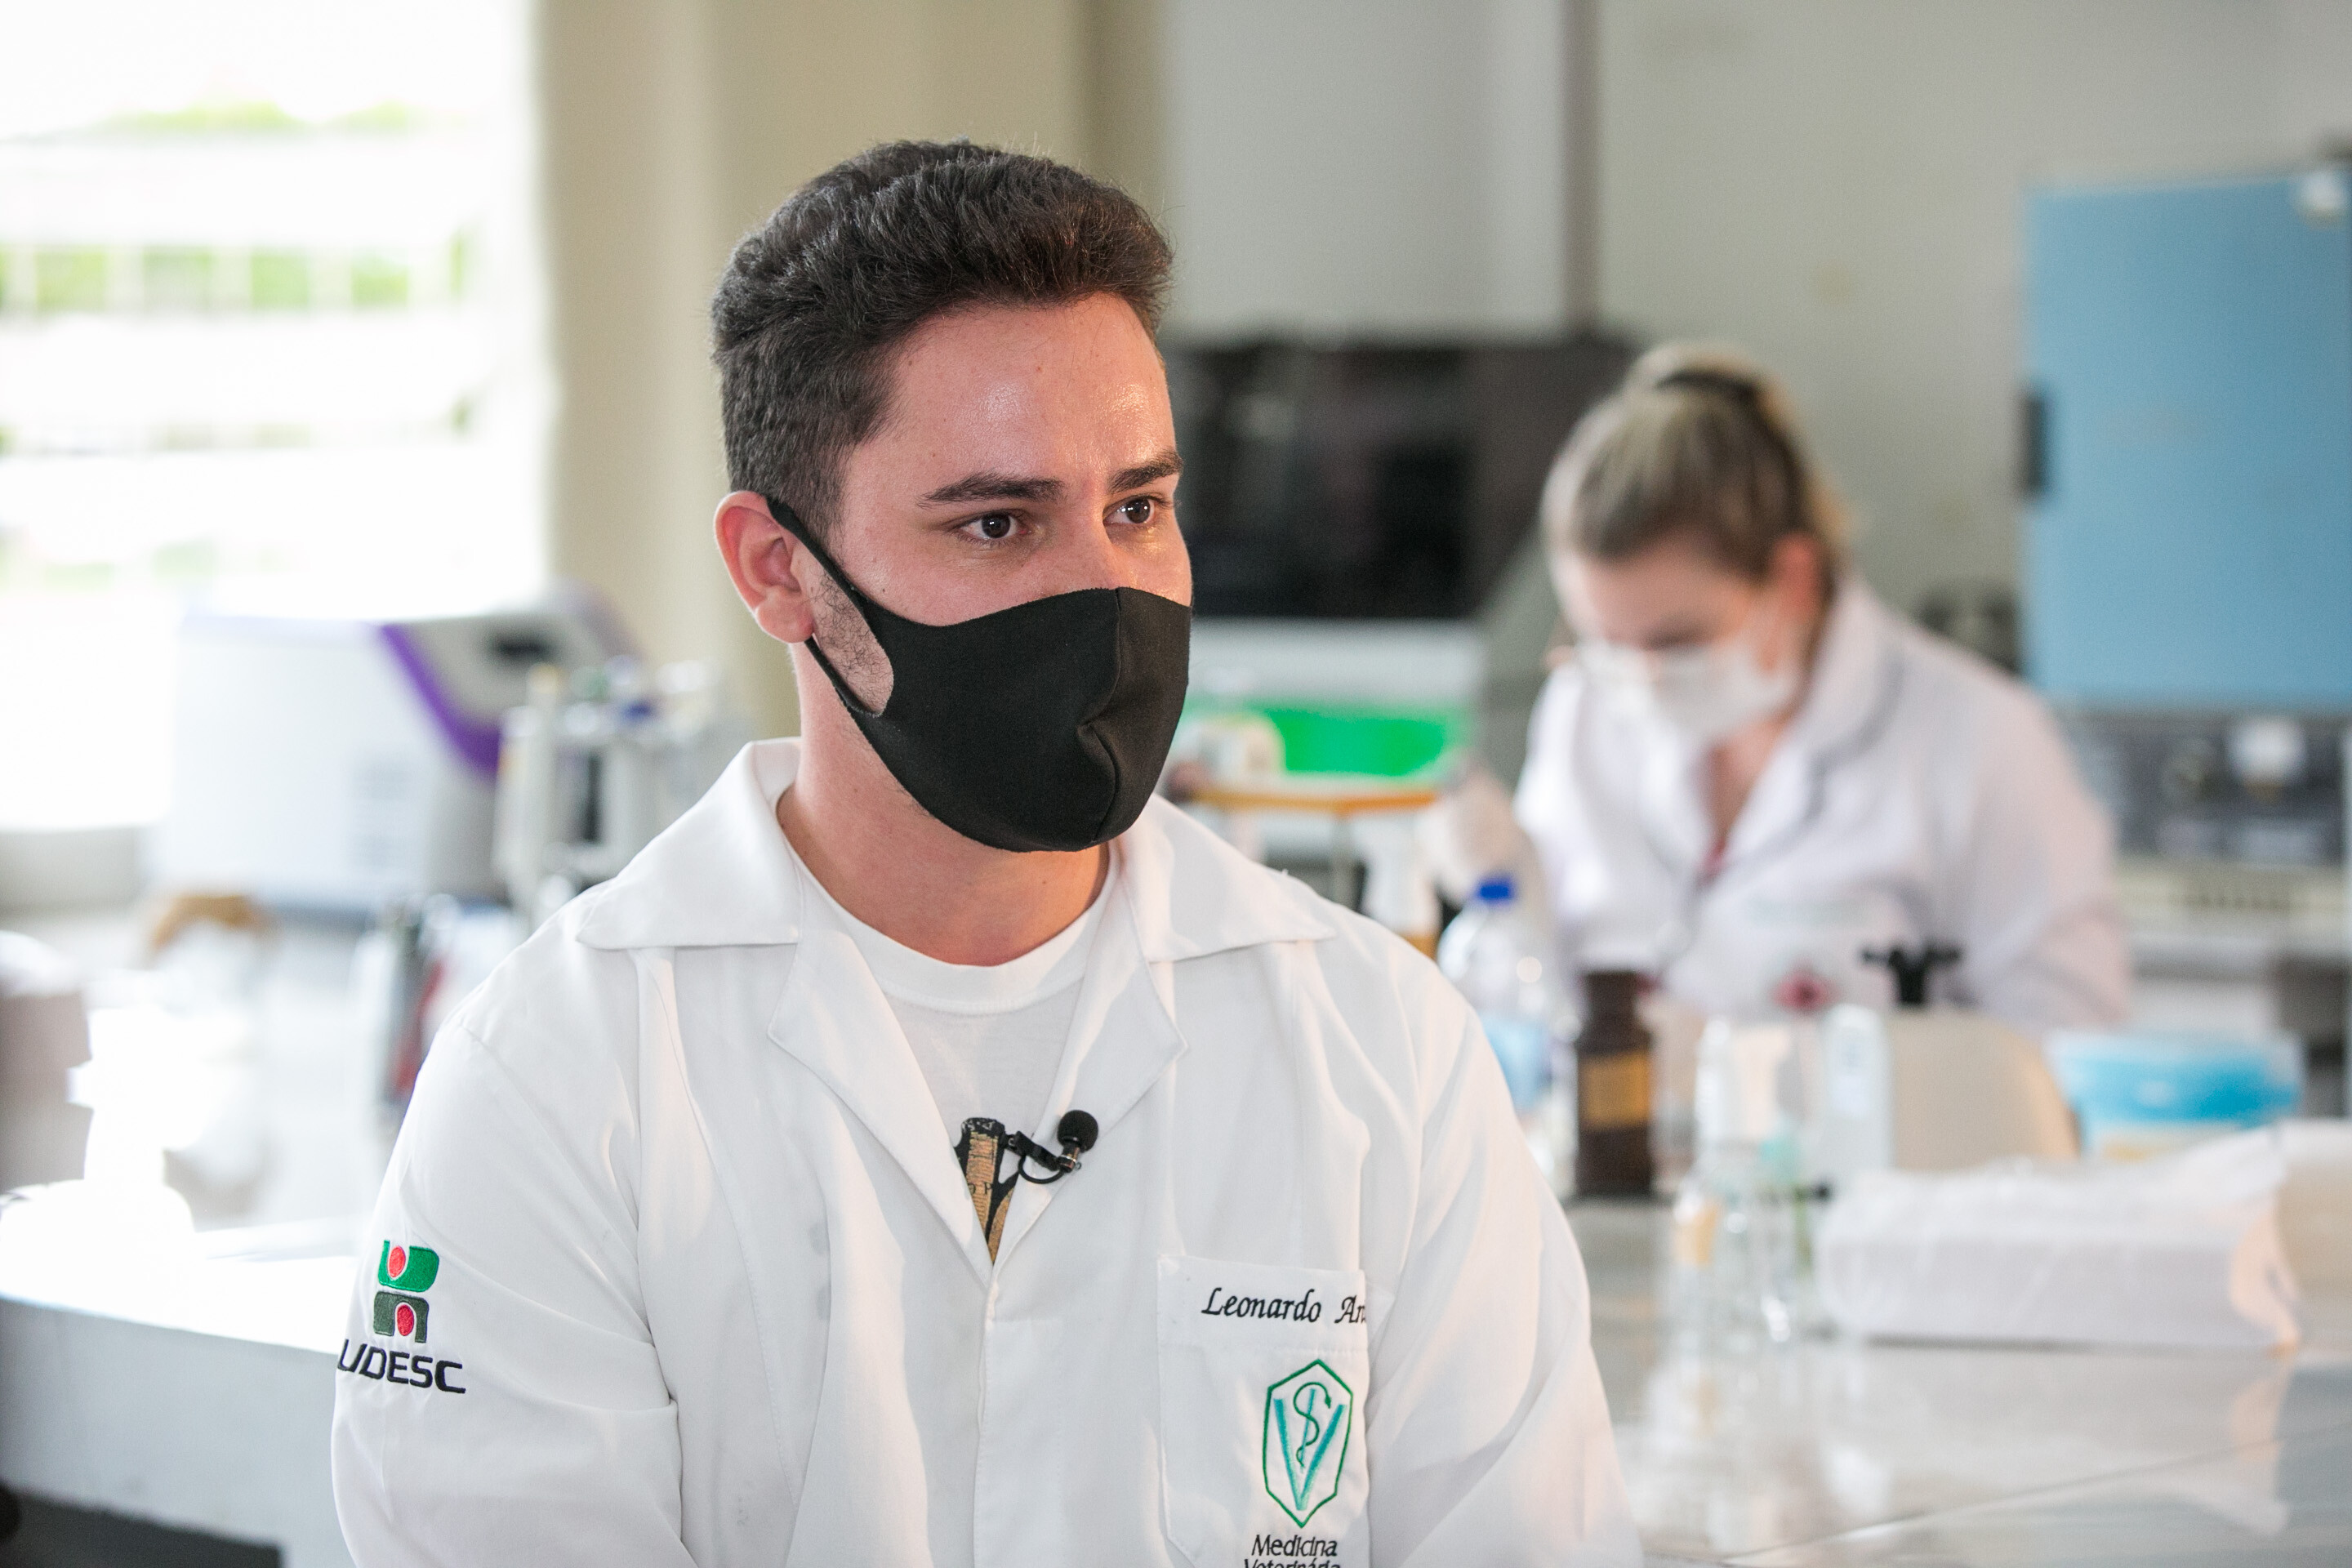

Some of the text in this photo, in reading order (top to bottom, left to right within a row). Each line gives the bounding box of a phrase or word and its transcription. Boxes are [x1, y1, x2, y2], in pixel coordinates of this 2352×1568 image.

[1200, 1287, 1321, 1323] Leonardo
[336, 1339, 466, 1393] UDESC
[1251, 1534, 1338, 1557] Medicina
